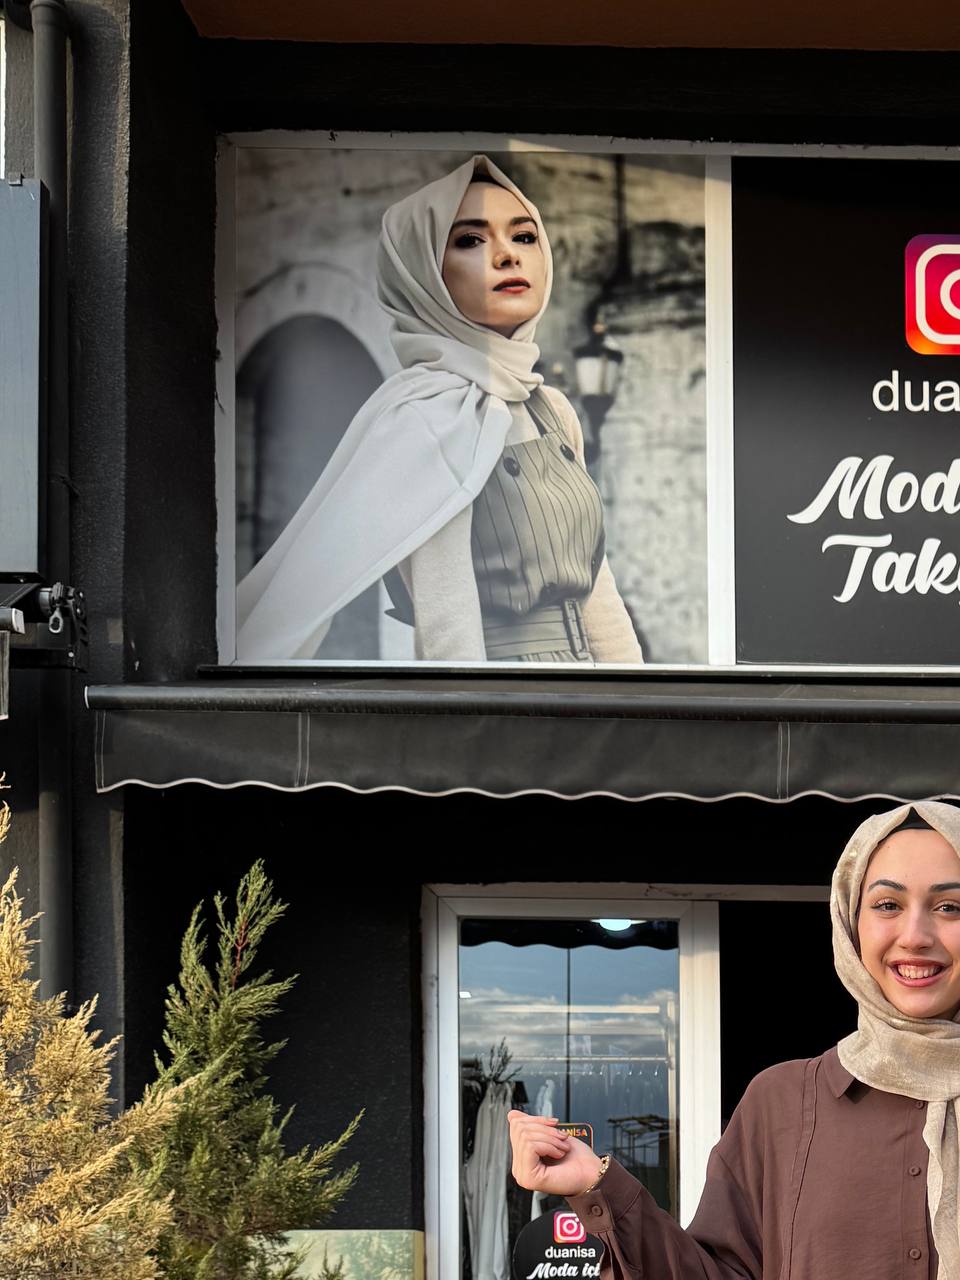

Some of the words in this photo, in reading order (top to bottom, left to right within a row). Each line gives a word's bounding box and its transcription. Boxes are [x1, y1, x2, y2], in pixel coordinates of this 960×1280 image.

[545, 1246, 595, 1258] duanisa
[527, 1263, 578, 1279] Moda
[581, 1262, 601, 1278] içi
